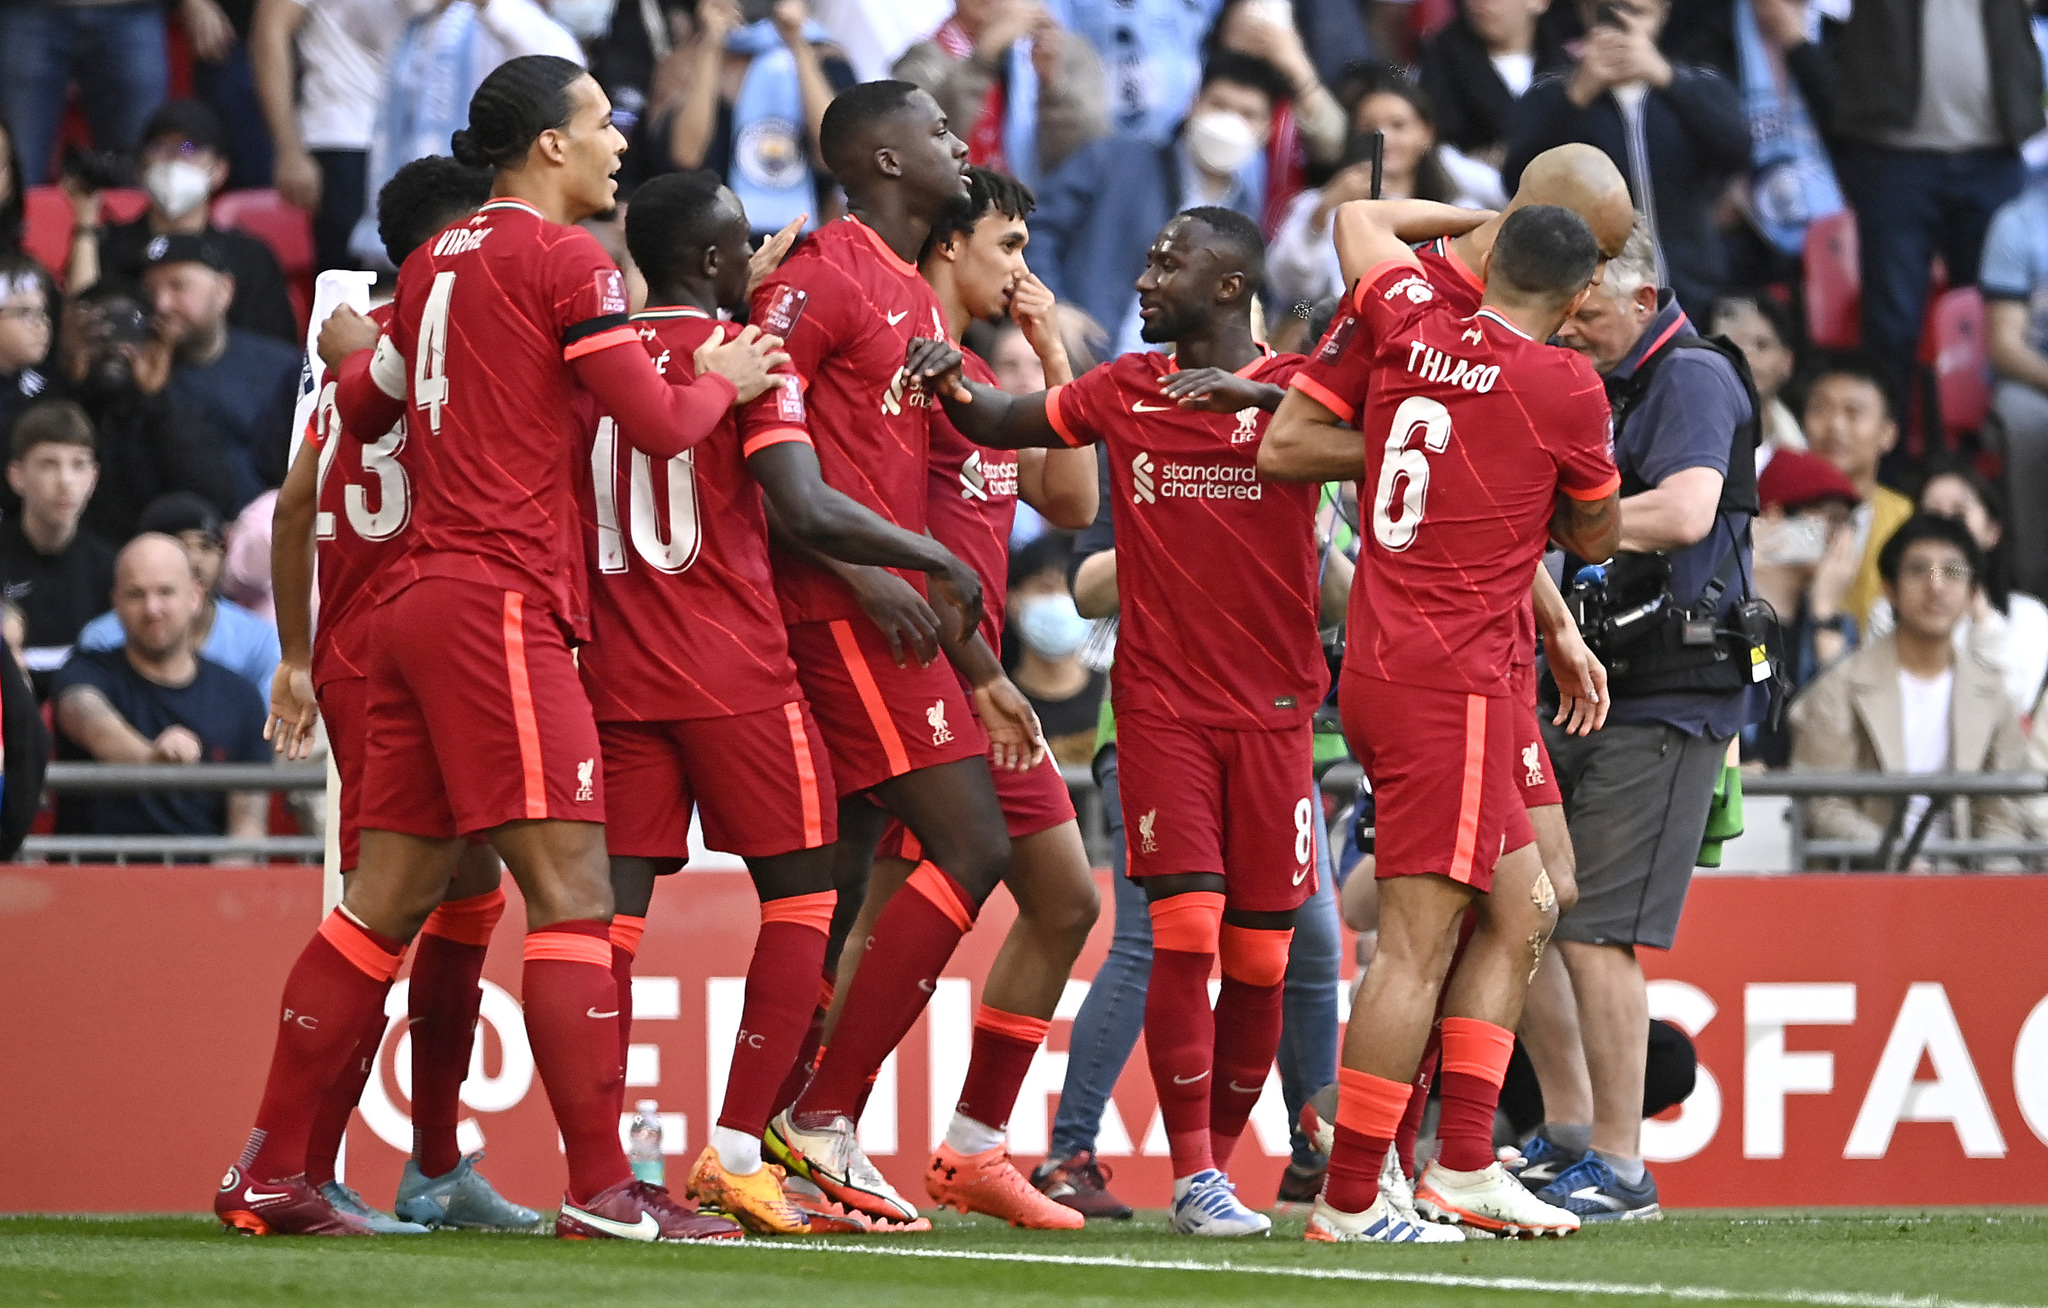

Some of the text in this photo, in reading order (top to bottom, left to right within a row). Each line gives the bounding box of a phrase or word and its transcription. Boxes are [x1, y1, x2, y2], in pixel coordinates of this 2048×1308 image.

[414, 270, 457, 436] 4
[1407, 340, 1501, 394] THIAGO
[1230, 432, 1256, 444] LFC
[316, 381, 412, 542] 23
[982, 460, 1018, 480] standa
[1161, 462, 1257, 483] standard
[1373, 395, 1452, 553] 6
[590, 415, 702, 575] 10
[1160, 480, 1262, 501] chartered
[932, 731, 955, 746] LFC
[1525, 775, 1546, 787] LFC
[576, 791, 594, 801] LFC
[1294, 797, 1312, 865] 8
